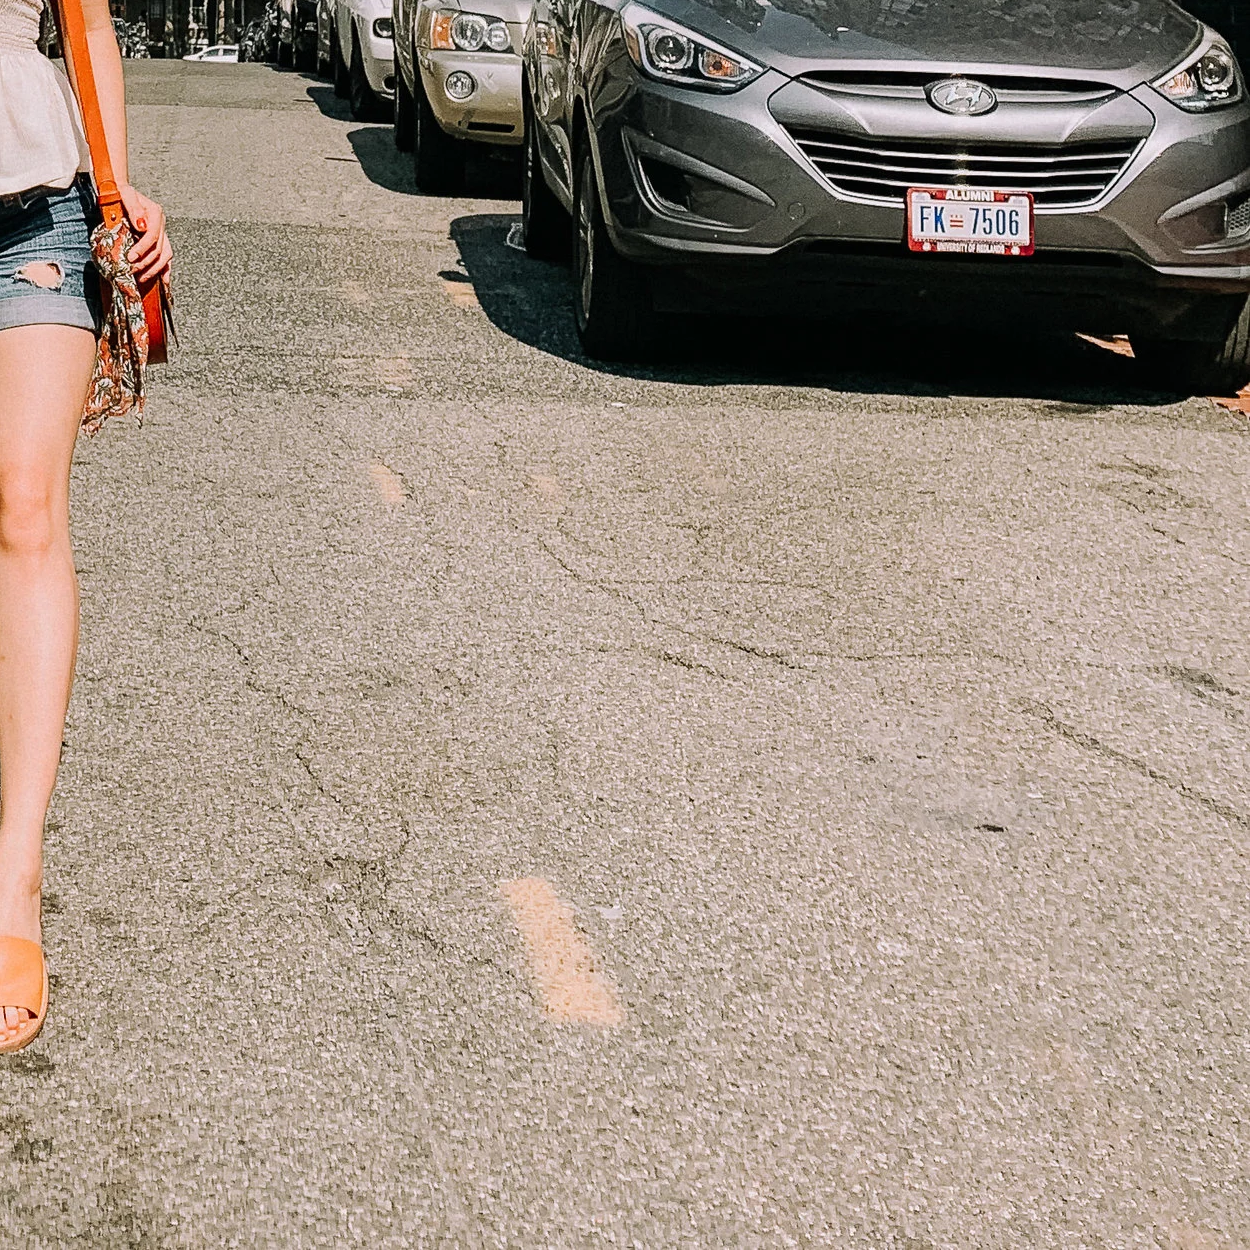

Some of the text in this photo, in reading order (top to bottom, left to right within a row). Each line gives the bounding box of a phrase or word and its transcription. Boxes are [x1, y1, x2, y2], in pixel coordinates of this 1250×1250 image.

[945, 189, 995, 202] ALUMNI
[920, 206, 1019, 236] FK 7506
